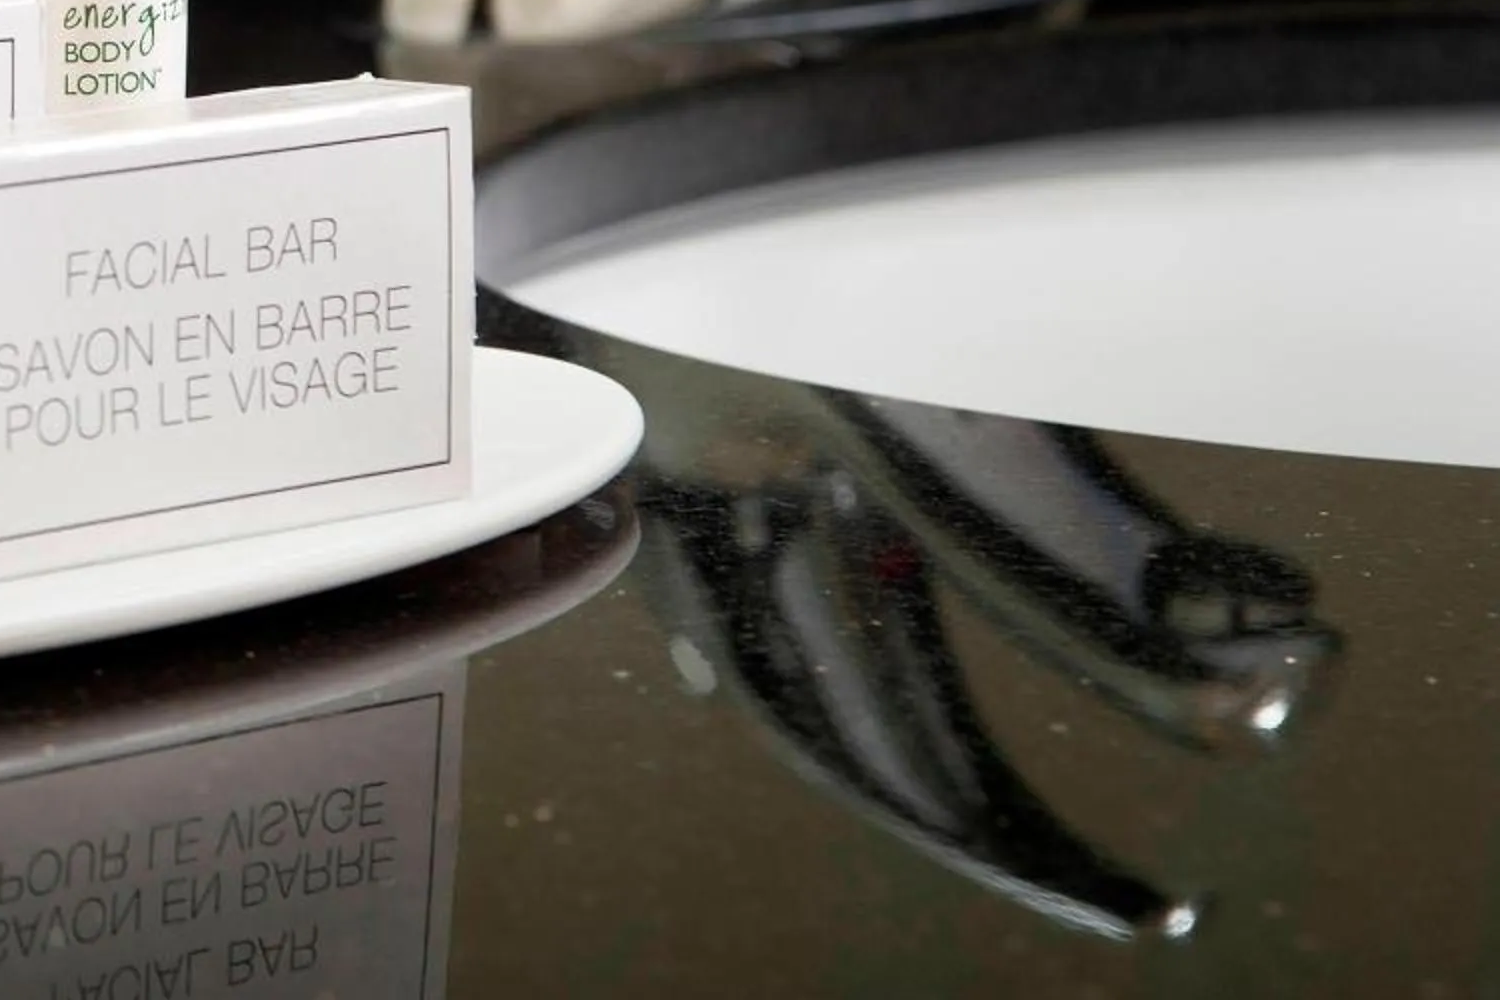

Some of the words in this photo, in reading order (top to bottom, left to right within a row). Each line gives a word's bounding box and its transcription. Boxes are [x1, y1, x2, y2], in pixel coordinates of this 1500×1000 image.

[64, 40, 136, 64] BODY
[64, 234, 226, 299] FACIAL
[245, 215, 340, 274] BAR
[176, 308, 237, 364] EN
[255, 285, 412, 351] BARRE
[5, 386, 140, 452] POUR
[158, 373, 213, 428] LE
[228, 346, 401, 415] VISAGE
